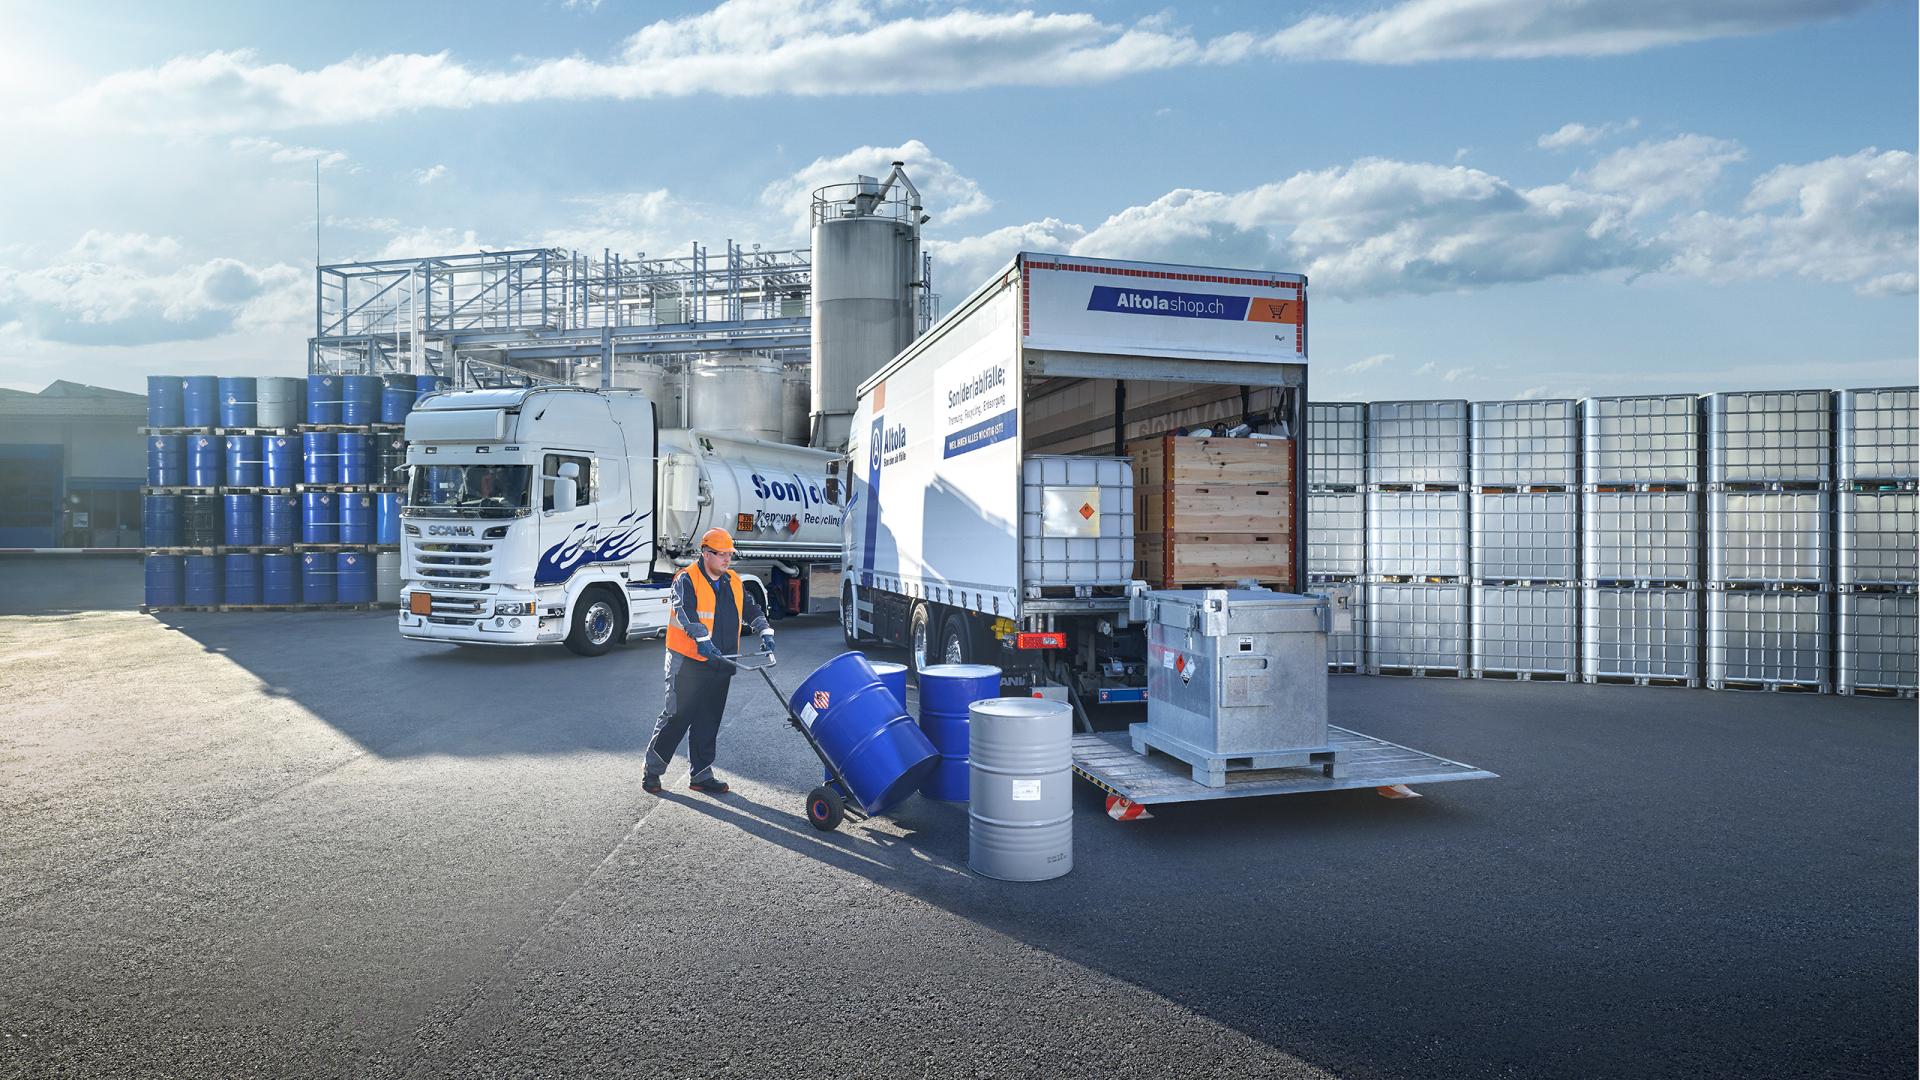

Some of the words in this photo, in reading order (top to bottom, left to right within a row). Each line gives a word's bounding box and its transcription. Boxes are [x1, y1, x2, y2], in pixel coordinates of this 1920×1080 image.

[1117, 293, 1224, 316] Altolashop.ch
[884, 422, 906, 454] Altola
[428, 525, 475, 537] SCANIA
